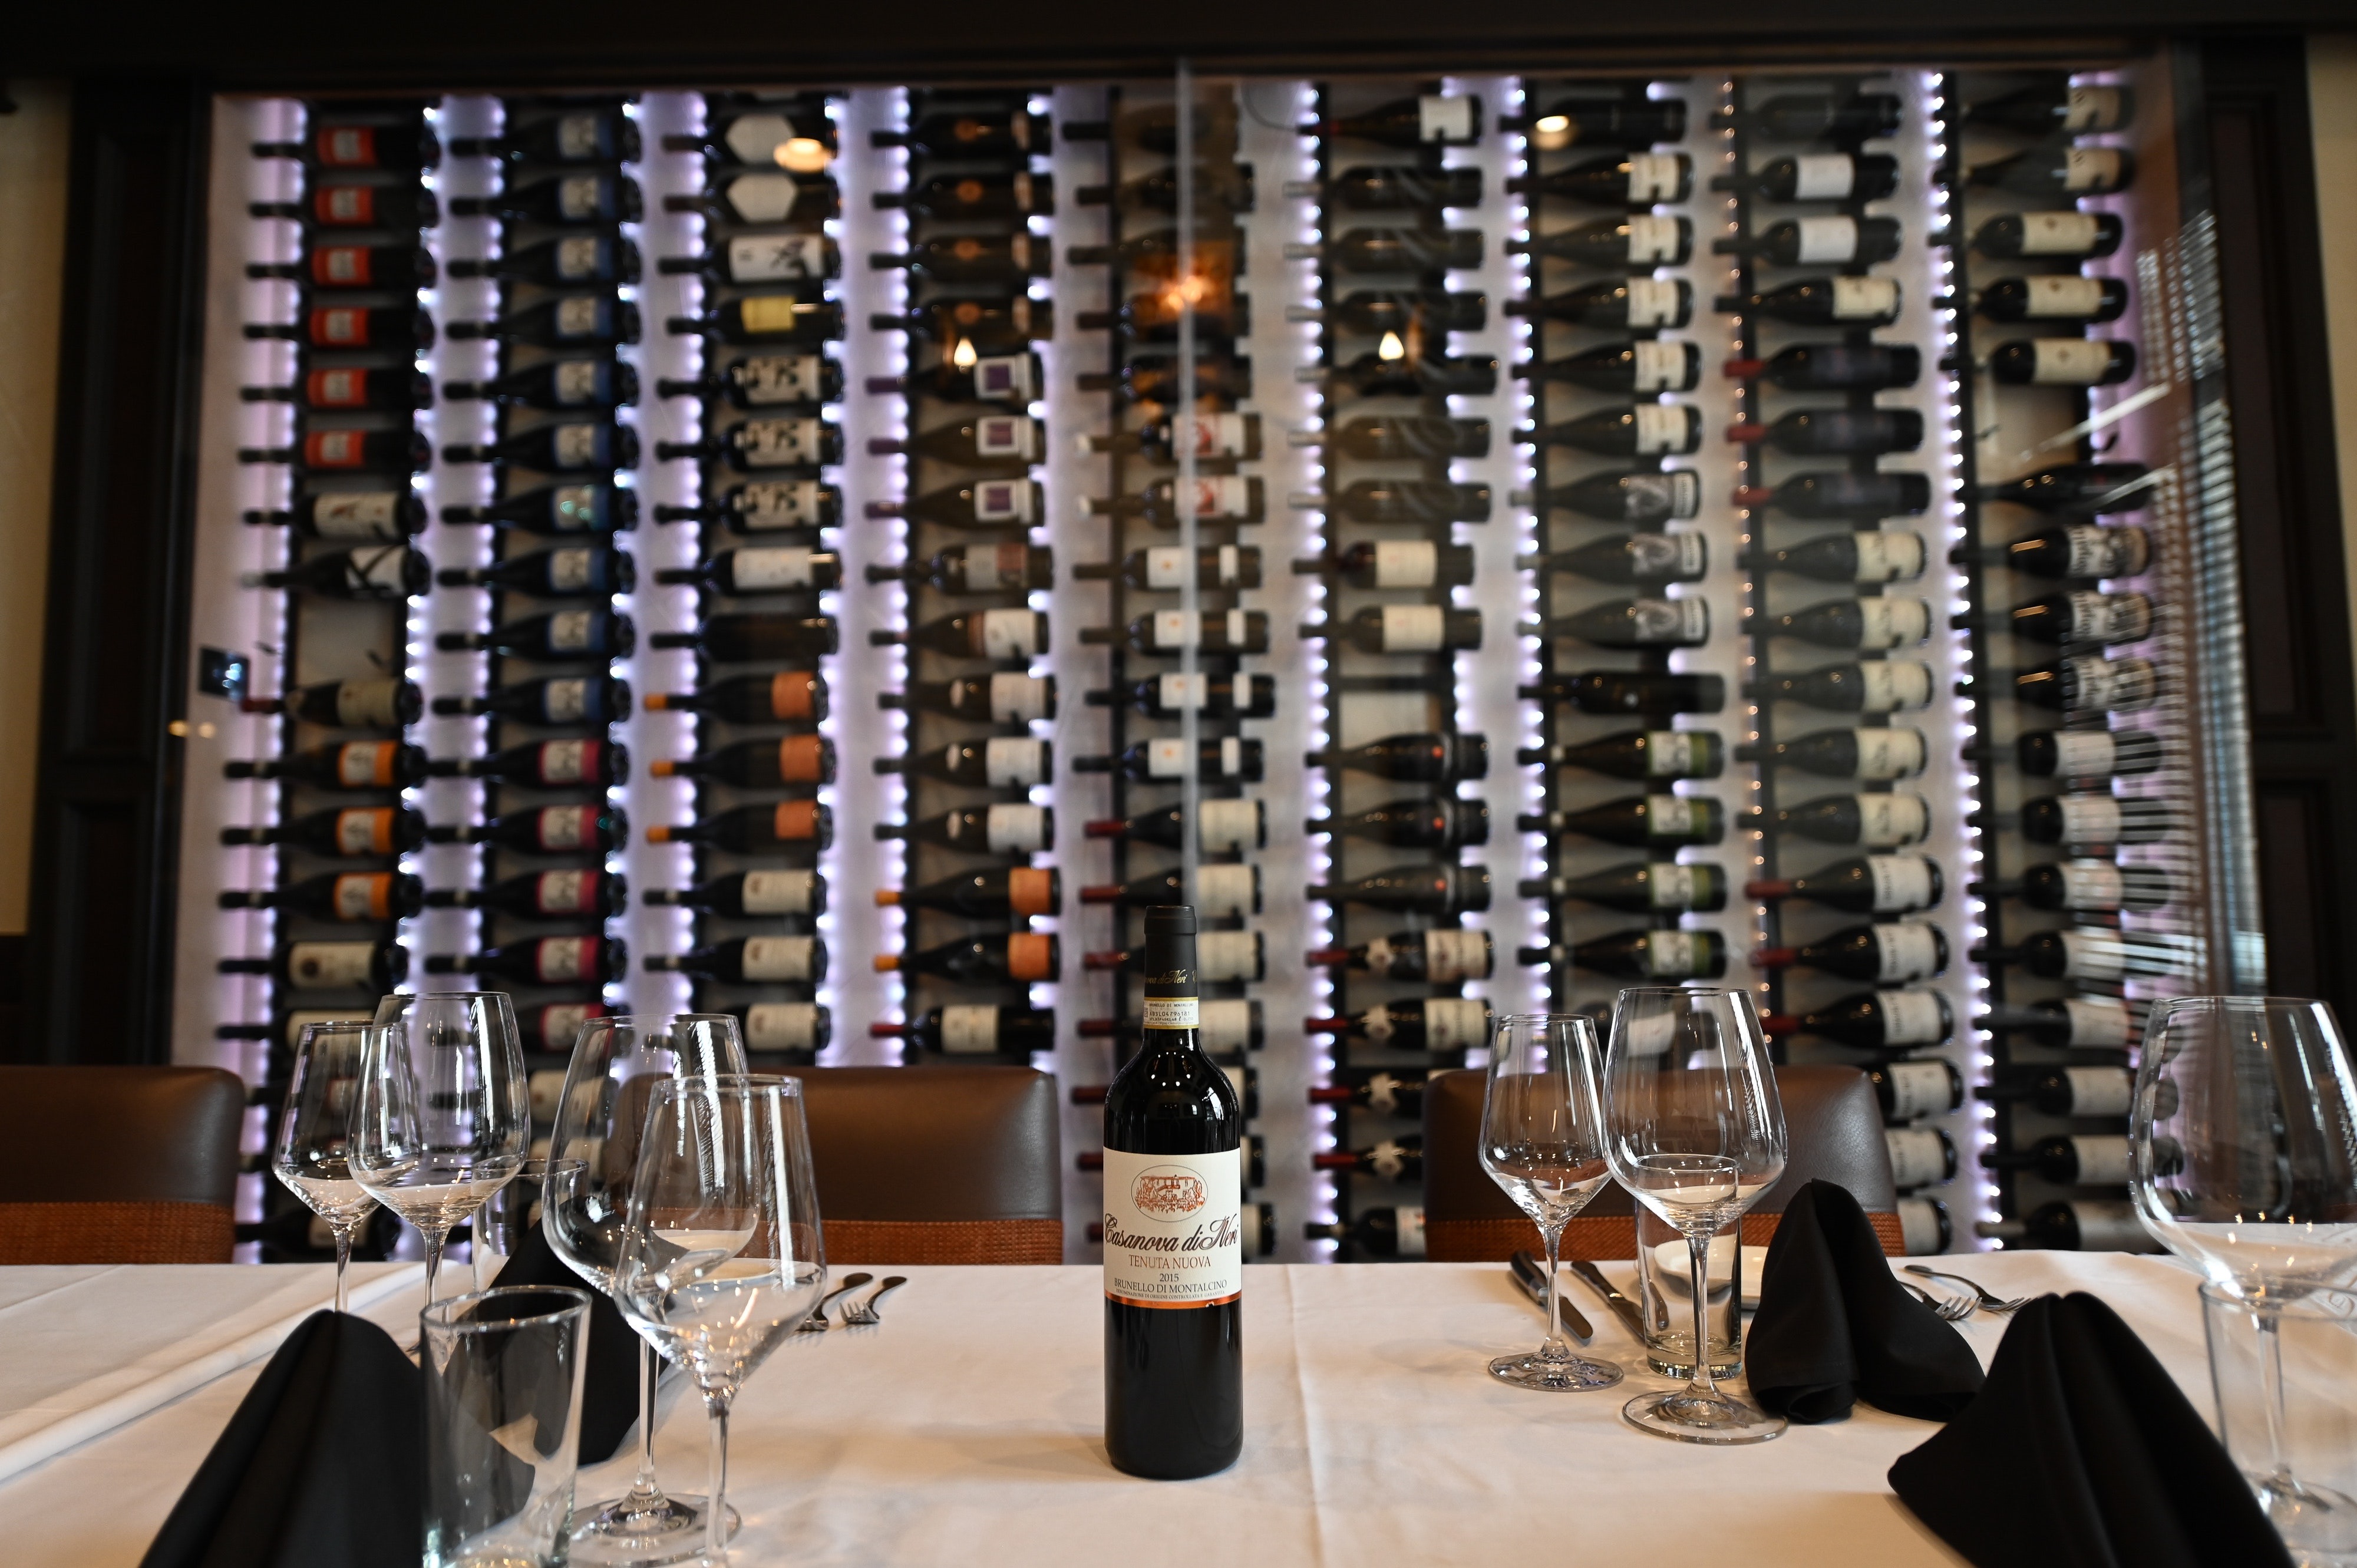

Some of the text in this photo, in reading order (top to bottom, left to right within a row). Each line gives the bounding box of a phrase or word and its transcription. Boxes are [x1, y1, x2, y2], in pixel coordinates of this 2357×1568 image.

[1157, 972, 1165, 984] di
[1164, 969, 1187, 984] Neri
[1105, 1213, 1239, 1252] Casanova di Neri
[1129, 1255, 1211, 1269] TENUTA NUOVA
[1159, 1273, 1179, 1282] 2015
[1114, 1277, 1227, 1293] BRUNELLO DI MONTALCINO
[1116, 1289, 1144, 1298] DENOMINAZIONE
